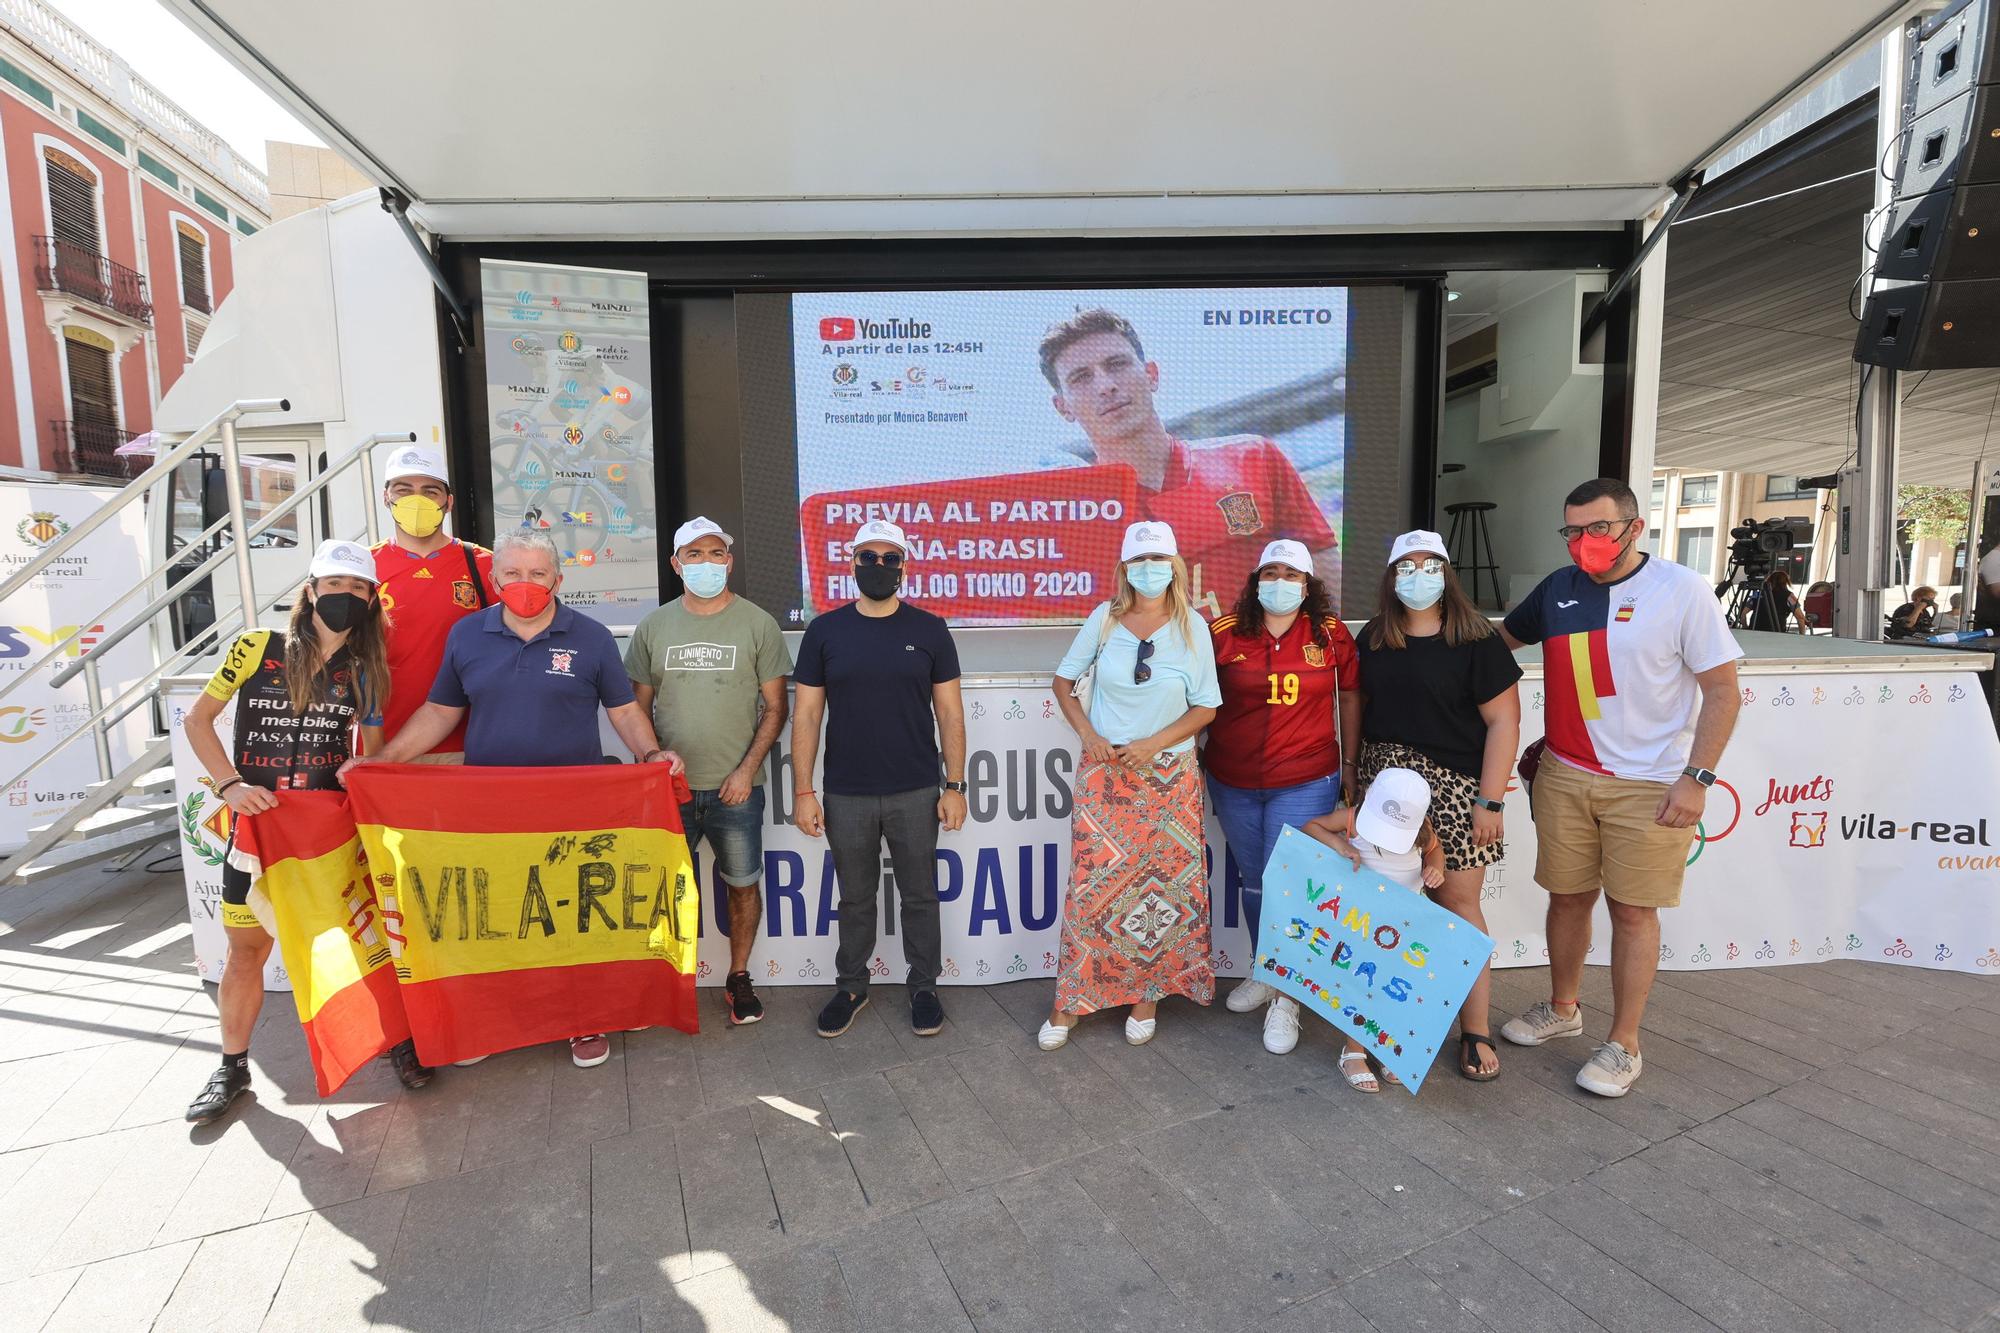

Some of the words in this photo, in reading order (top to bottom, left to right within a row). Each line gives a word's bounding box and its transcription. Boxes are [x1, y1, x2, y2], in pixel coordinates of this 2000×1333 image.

[591, 302, 632, 313] MAINZU
[1203, 309, 1232, 325] EN
[1239, 308, 1332, 325] DIRECTO
[857, 317, 932, 340] YouTube
[822, 343, 833, 355] A
[837, 342, 881, 358] partir
[886, 342, 904, 354] de
[908, 342, 930, 354] las
[934, 341, 984, 354] 12:45H
[508, 384, 550, 395] MAINZU
[825, 412, 875, 424] Presentado
[877, 413, 892, 425] por
[927, 410, 968, 423] Benavent
[555, 470, 596, 480] MAINZU
[561, 511, 593, 524] SME
[826, 501, 934, 525] PREVIA
[942, 501, 981, 523] AL
[990, 499, 1123, 522] PARTIDO
[827, 533, 1064, 563] ESÑA-BRASIL
[964, 571, 1026, 598] TOKIO
[1033, 571, 1092, 597] 2020
[678, 646, 722, 661] LINIMENTO
[1266, 673, 1300, 706] 19
[1755, 775, 1835, 816] Junts
[1937, 855, 2000, 871] avan
[407, 861, 692, 945] VILA-REAL
[1305, 877, 1430, 969] VAMOS
